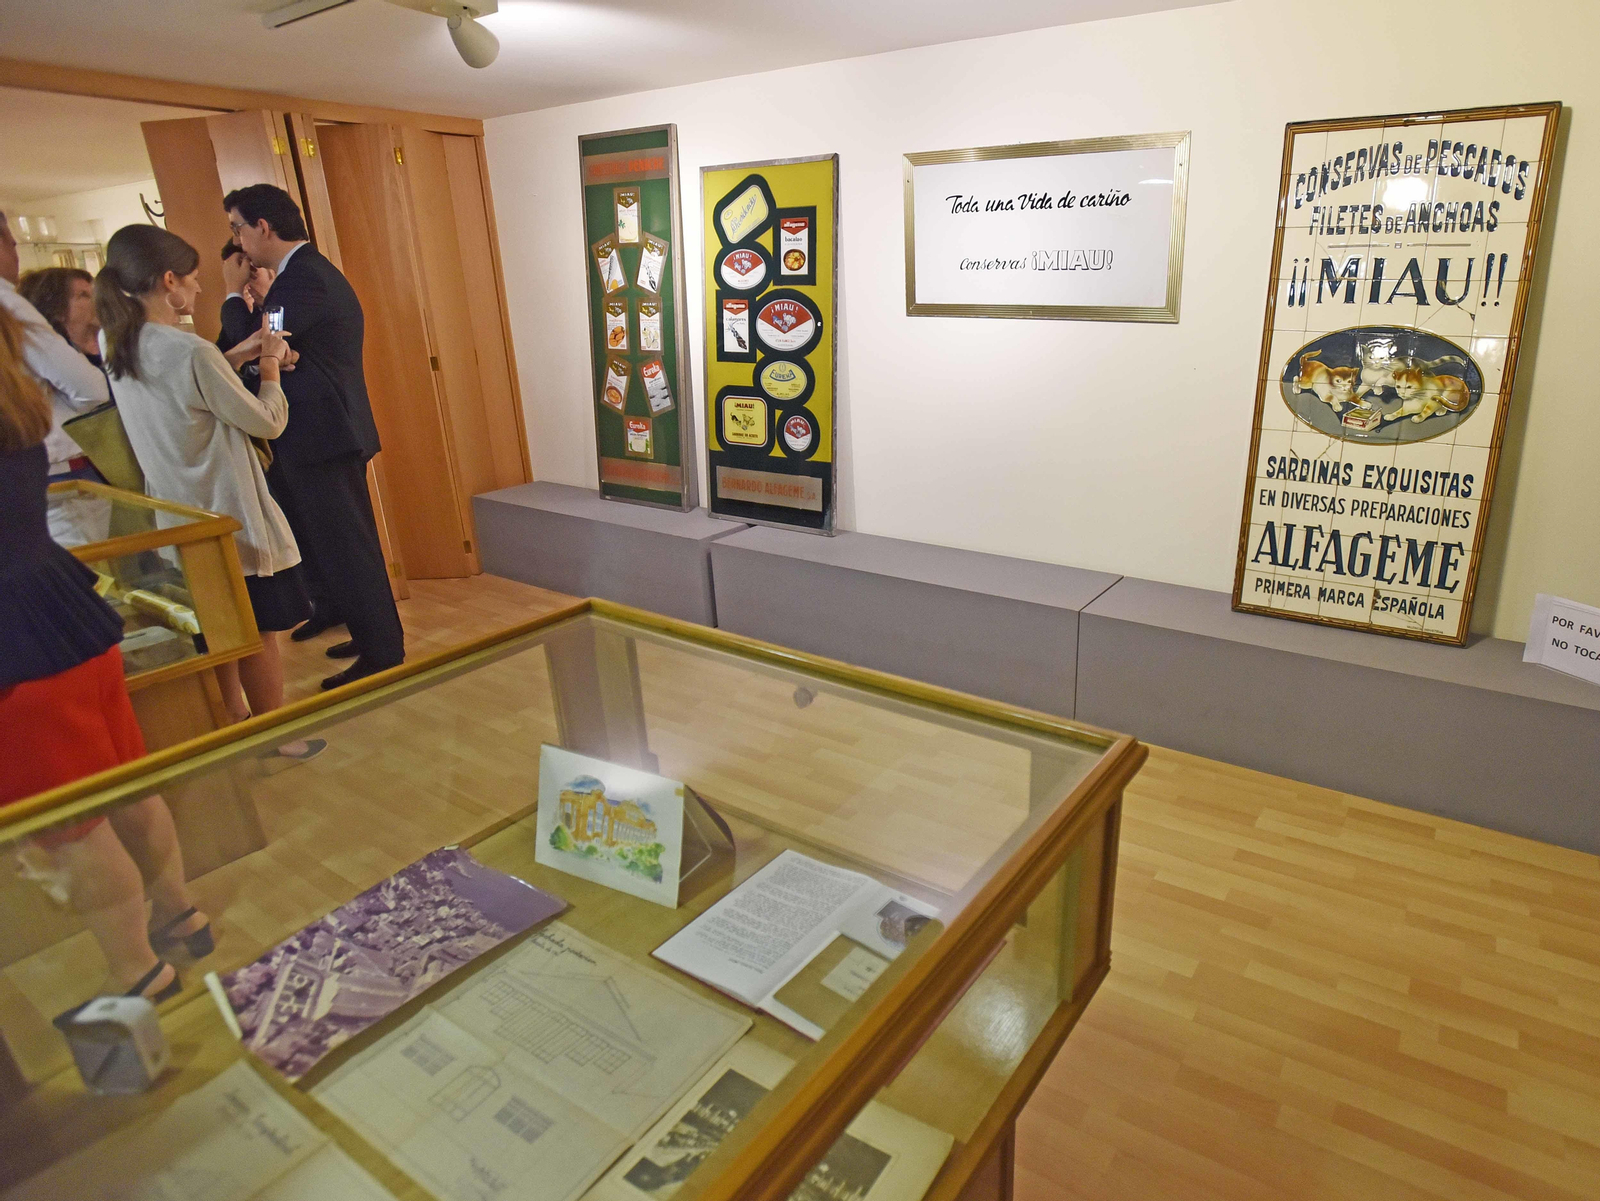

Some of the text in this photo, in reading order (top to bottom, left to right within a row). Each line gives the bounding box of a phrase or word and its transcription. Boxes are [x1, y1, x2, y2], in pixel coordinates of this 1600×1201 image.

[1294, 139, 1530, 209] CONSERVAS DE PESCADOS
[945, 188, 1132, 214] Toda una Vida de cariño
[1308, 201, 1500, 235] FILETES DE ANCHOAS
[959, 249, 1114, 271] Conservas ¡MIAU!
[1287, 252, 1509, 307] ¡¡MIAU!!
[771, 303, 799, 313] ¡MIAU!
[1266, 455, 1474, 498] SARDINAS EXQUISITAS
[1259, 489, 1471, 529] EN DIVERSAS PREPARACIONES
[1251, 520, 1465, 594] ALFAGEME
[1255, 577, 1445, 620] PRIMERA MARCA ESPAÑOLA
[1551, 615, 1574, 630] POR
[1551, 638, 1569, 650] NO
